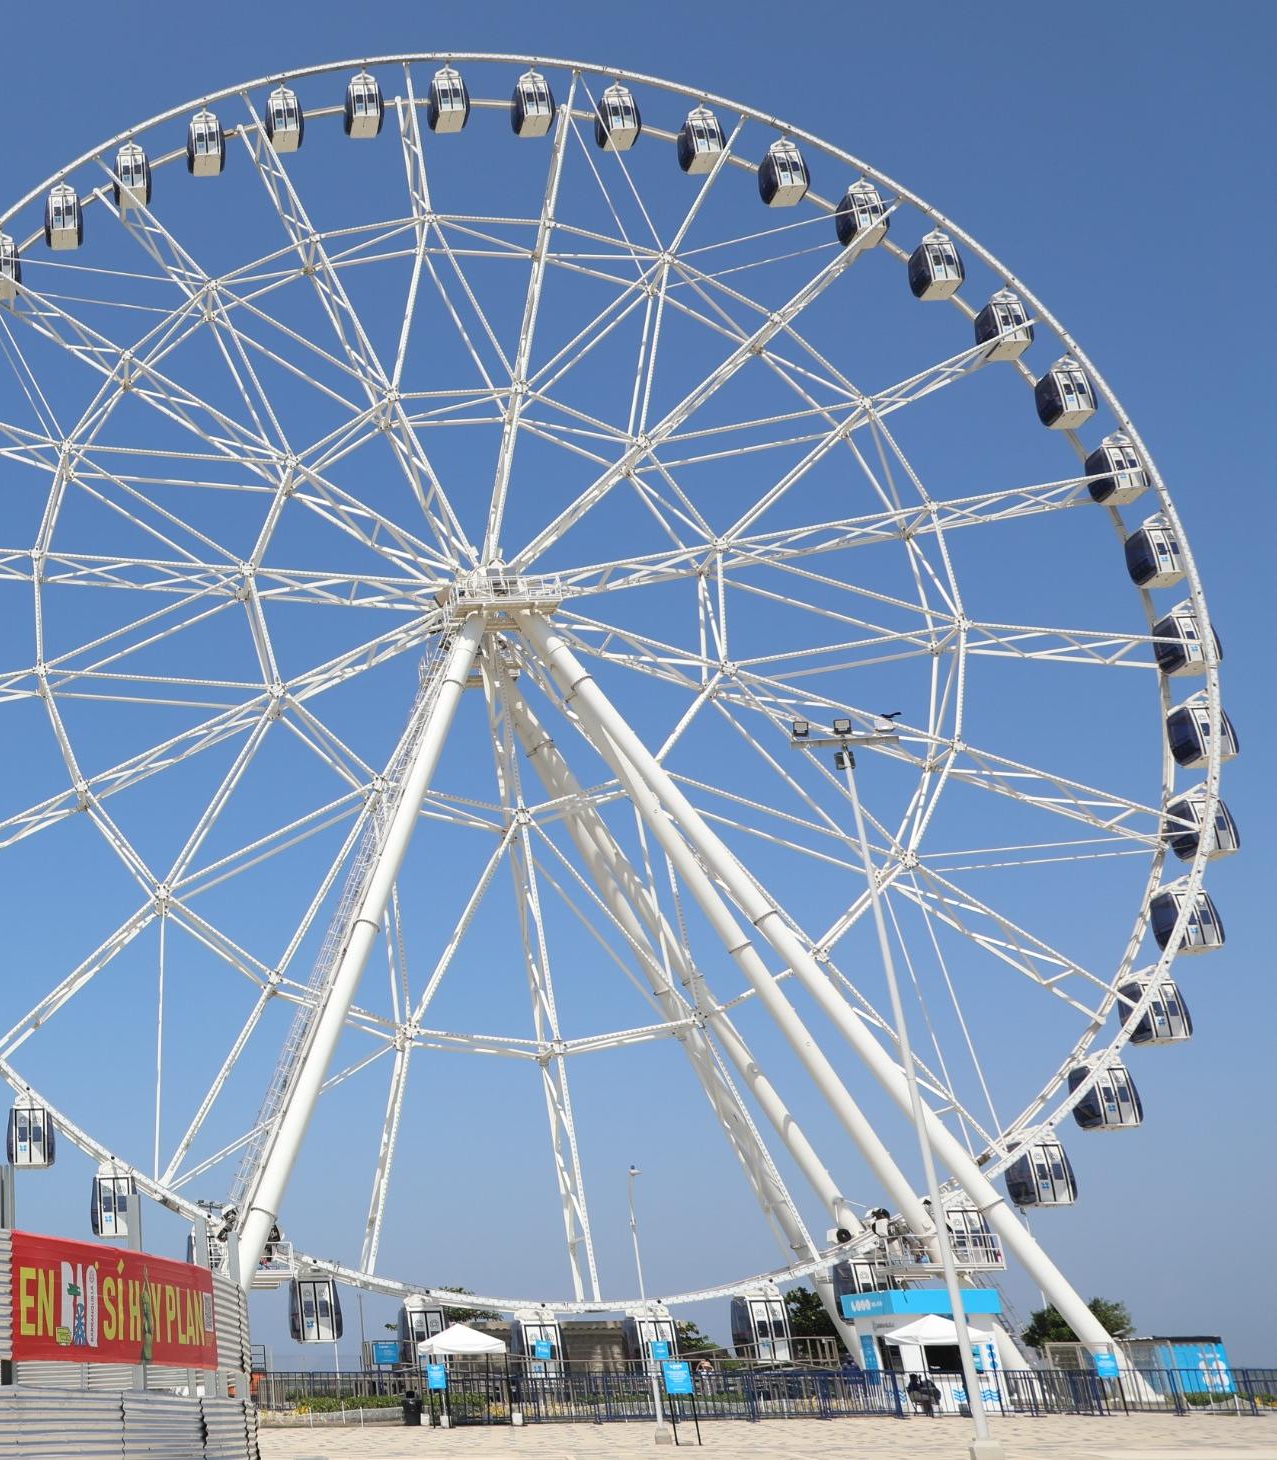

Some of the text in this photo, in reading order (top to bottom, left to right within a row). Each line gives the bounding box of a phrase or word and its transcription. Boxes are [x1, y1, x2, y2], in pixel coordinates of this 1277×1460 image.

[20, 1266, 55, 1337] EN
[103, 1258, 124, 1340] SÍ
[128, 1279, 161, 1343] HY
[165, 1285, 205, 1346] PLAN
